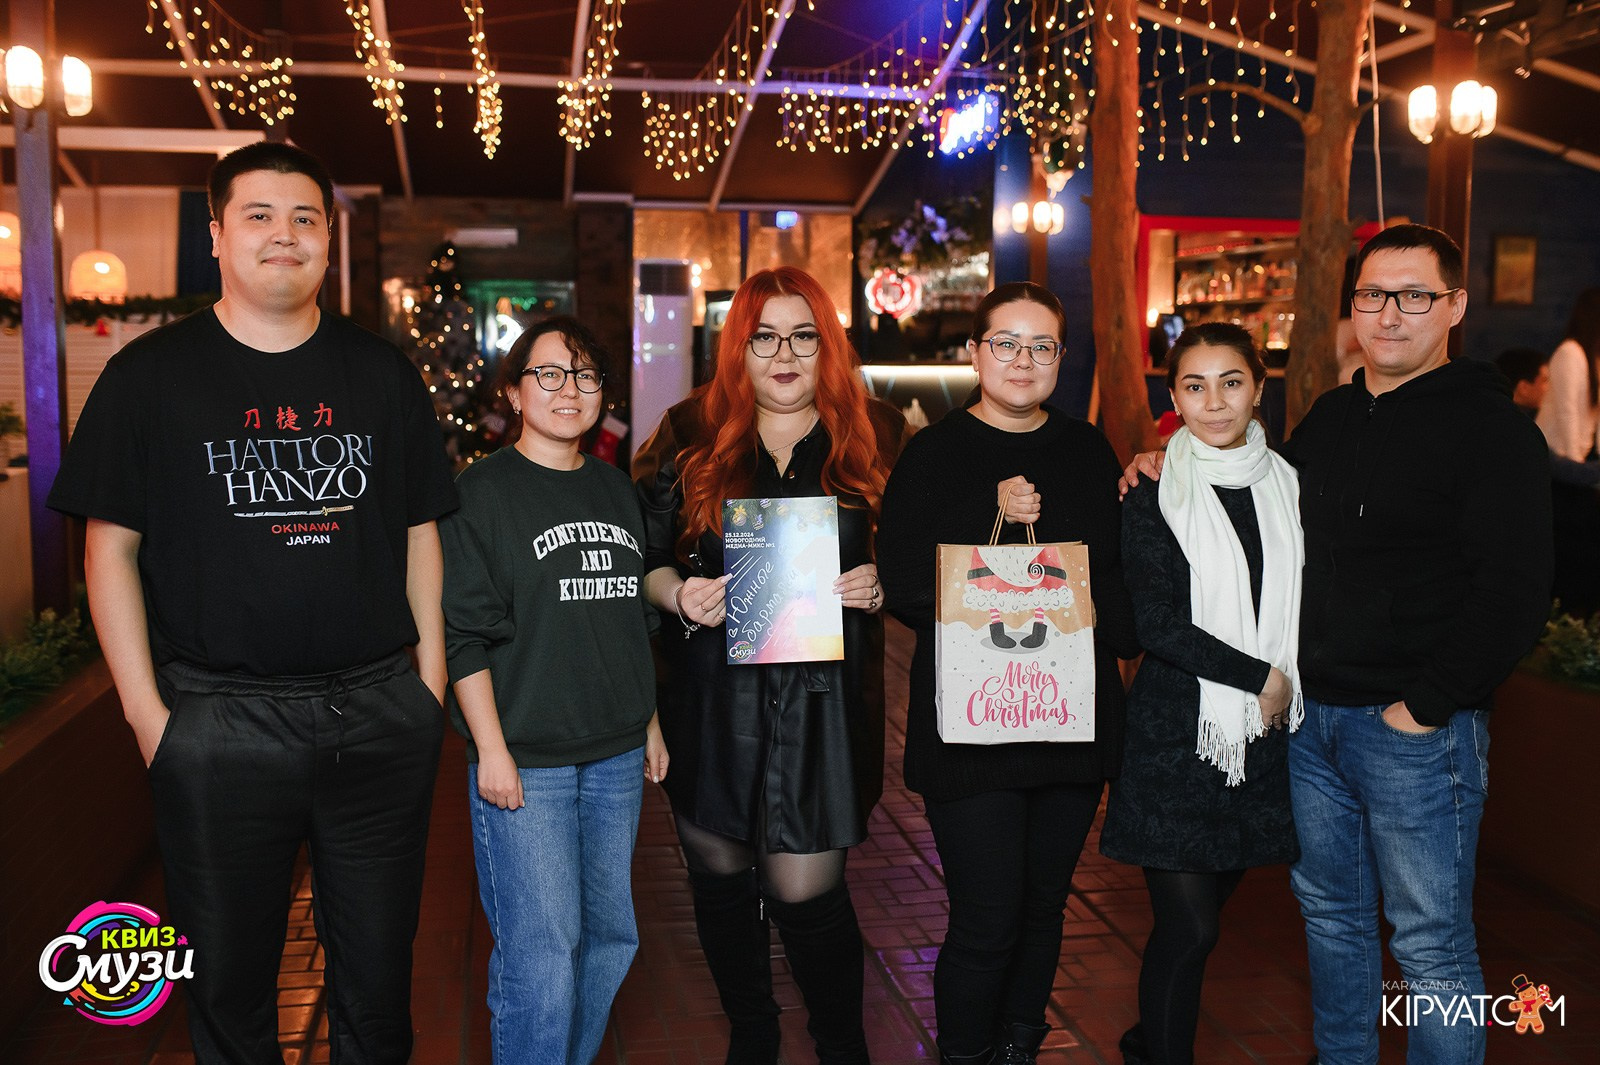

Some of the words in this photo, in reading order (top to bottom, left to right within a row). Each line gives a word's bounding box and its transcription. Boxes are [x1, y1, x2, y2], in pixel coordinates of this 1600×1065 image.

[203, 433, 373, 475] HATTORI
[223, 465, 367, 506] HANZO
[271, 521, 340, 534] OKINAWA
[286, 534, 331, 546] JAPAN
[580, 549, 613, 571] AND
[559, 576, 638, 601] KINDNESS
[727, 561, 775, 624] Южные
[729, 646, 757, 658] Смузи
[982, 660, 1060, 706] Merry
[966, 688, 1077, 728] Christmas
